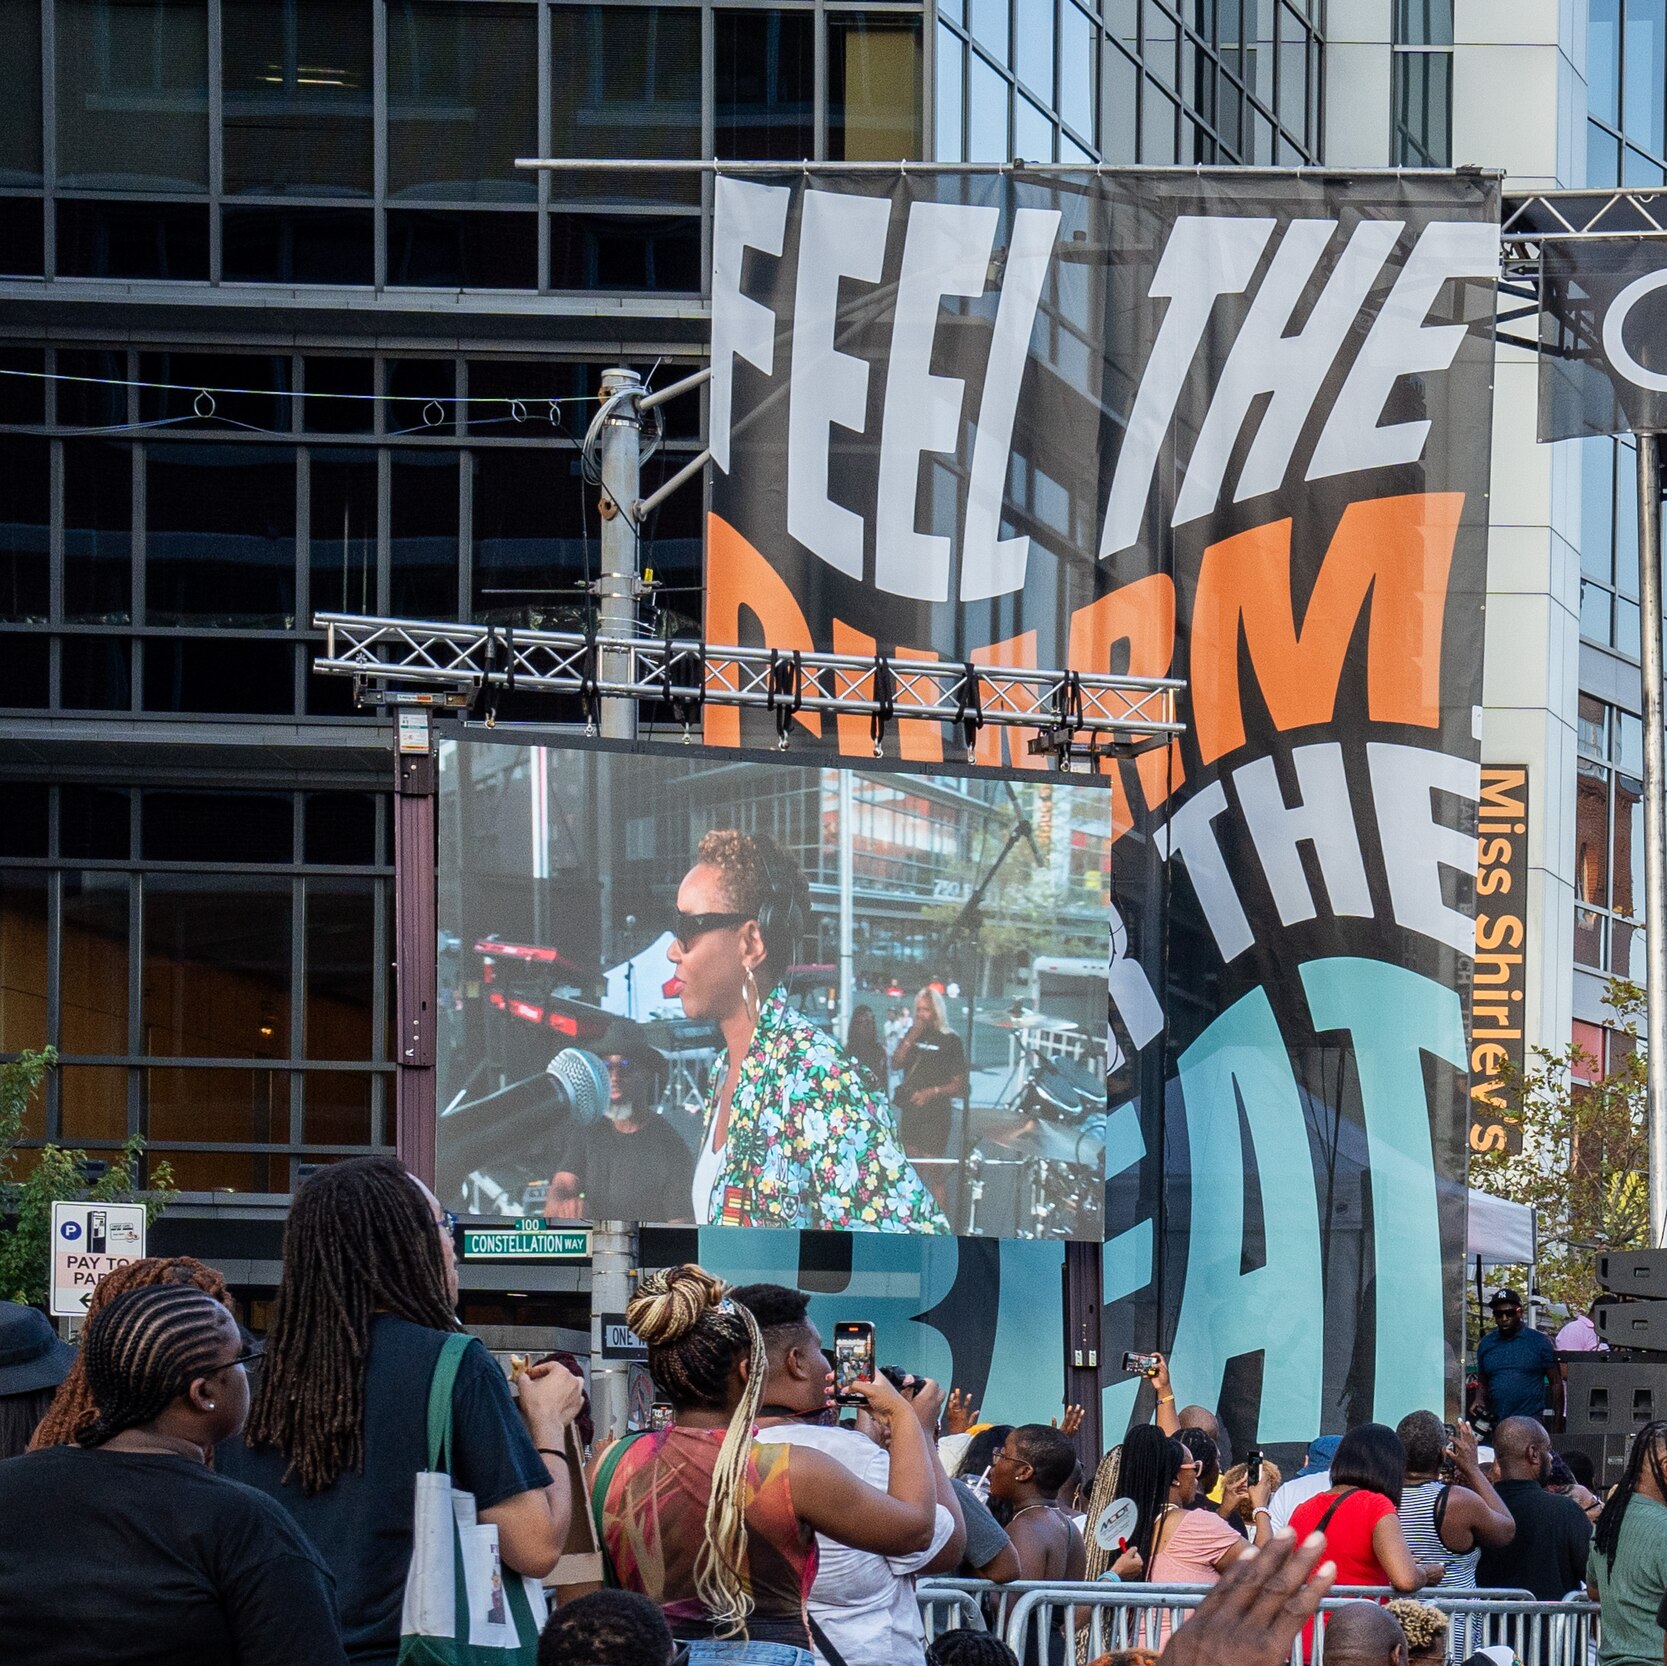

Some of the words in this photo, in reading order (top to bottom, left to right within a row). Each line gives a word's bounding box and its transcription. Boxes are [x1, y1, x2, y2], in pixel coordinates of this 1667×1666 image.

[711, 175, 1062, 602] FEEL
[1099, 215, 1500, 560] THE
[1478, 769, 1526, 896] Miss
[1154, 742, 1482, 964] THE
[521, 1219, 539, 1231] 100
[471, 1235, 563, 1253] CONSTELLATION
[564, 1238, 584, 1250] WAY
[67, 1256, 100, 1270] PAY
[612, 1327, 633, 1346] ONE
